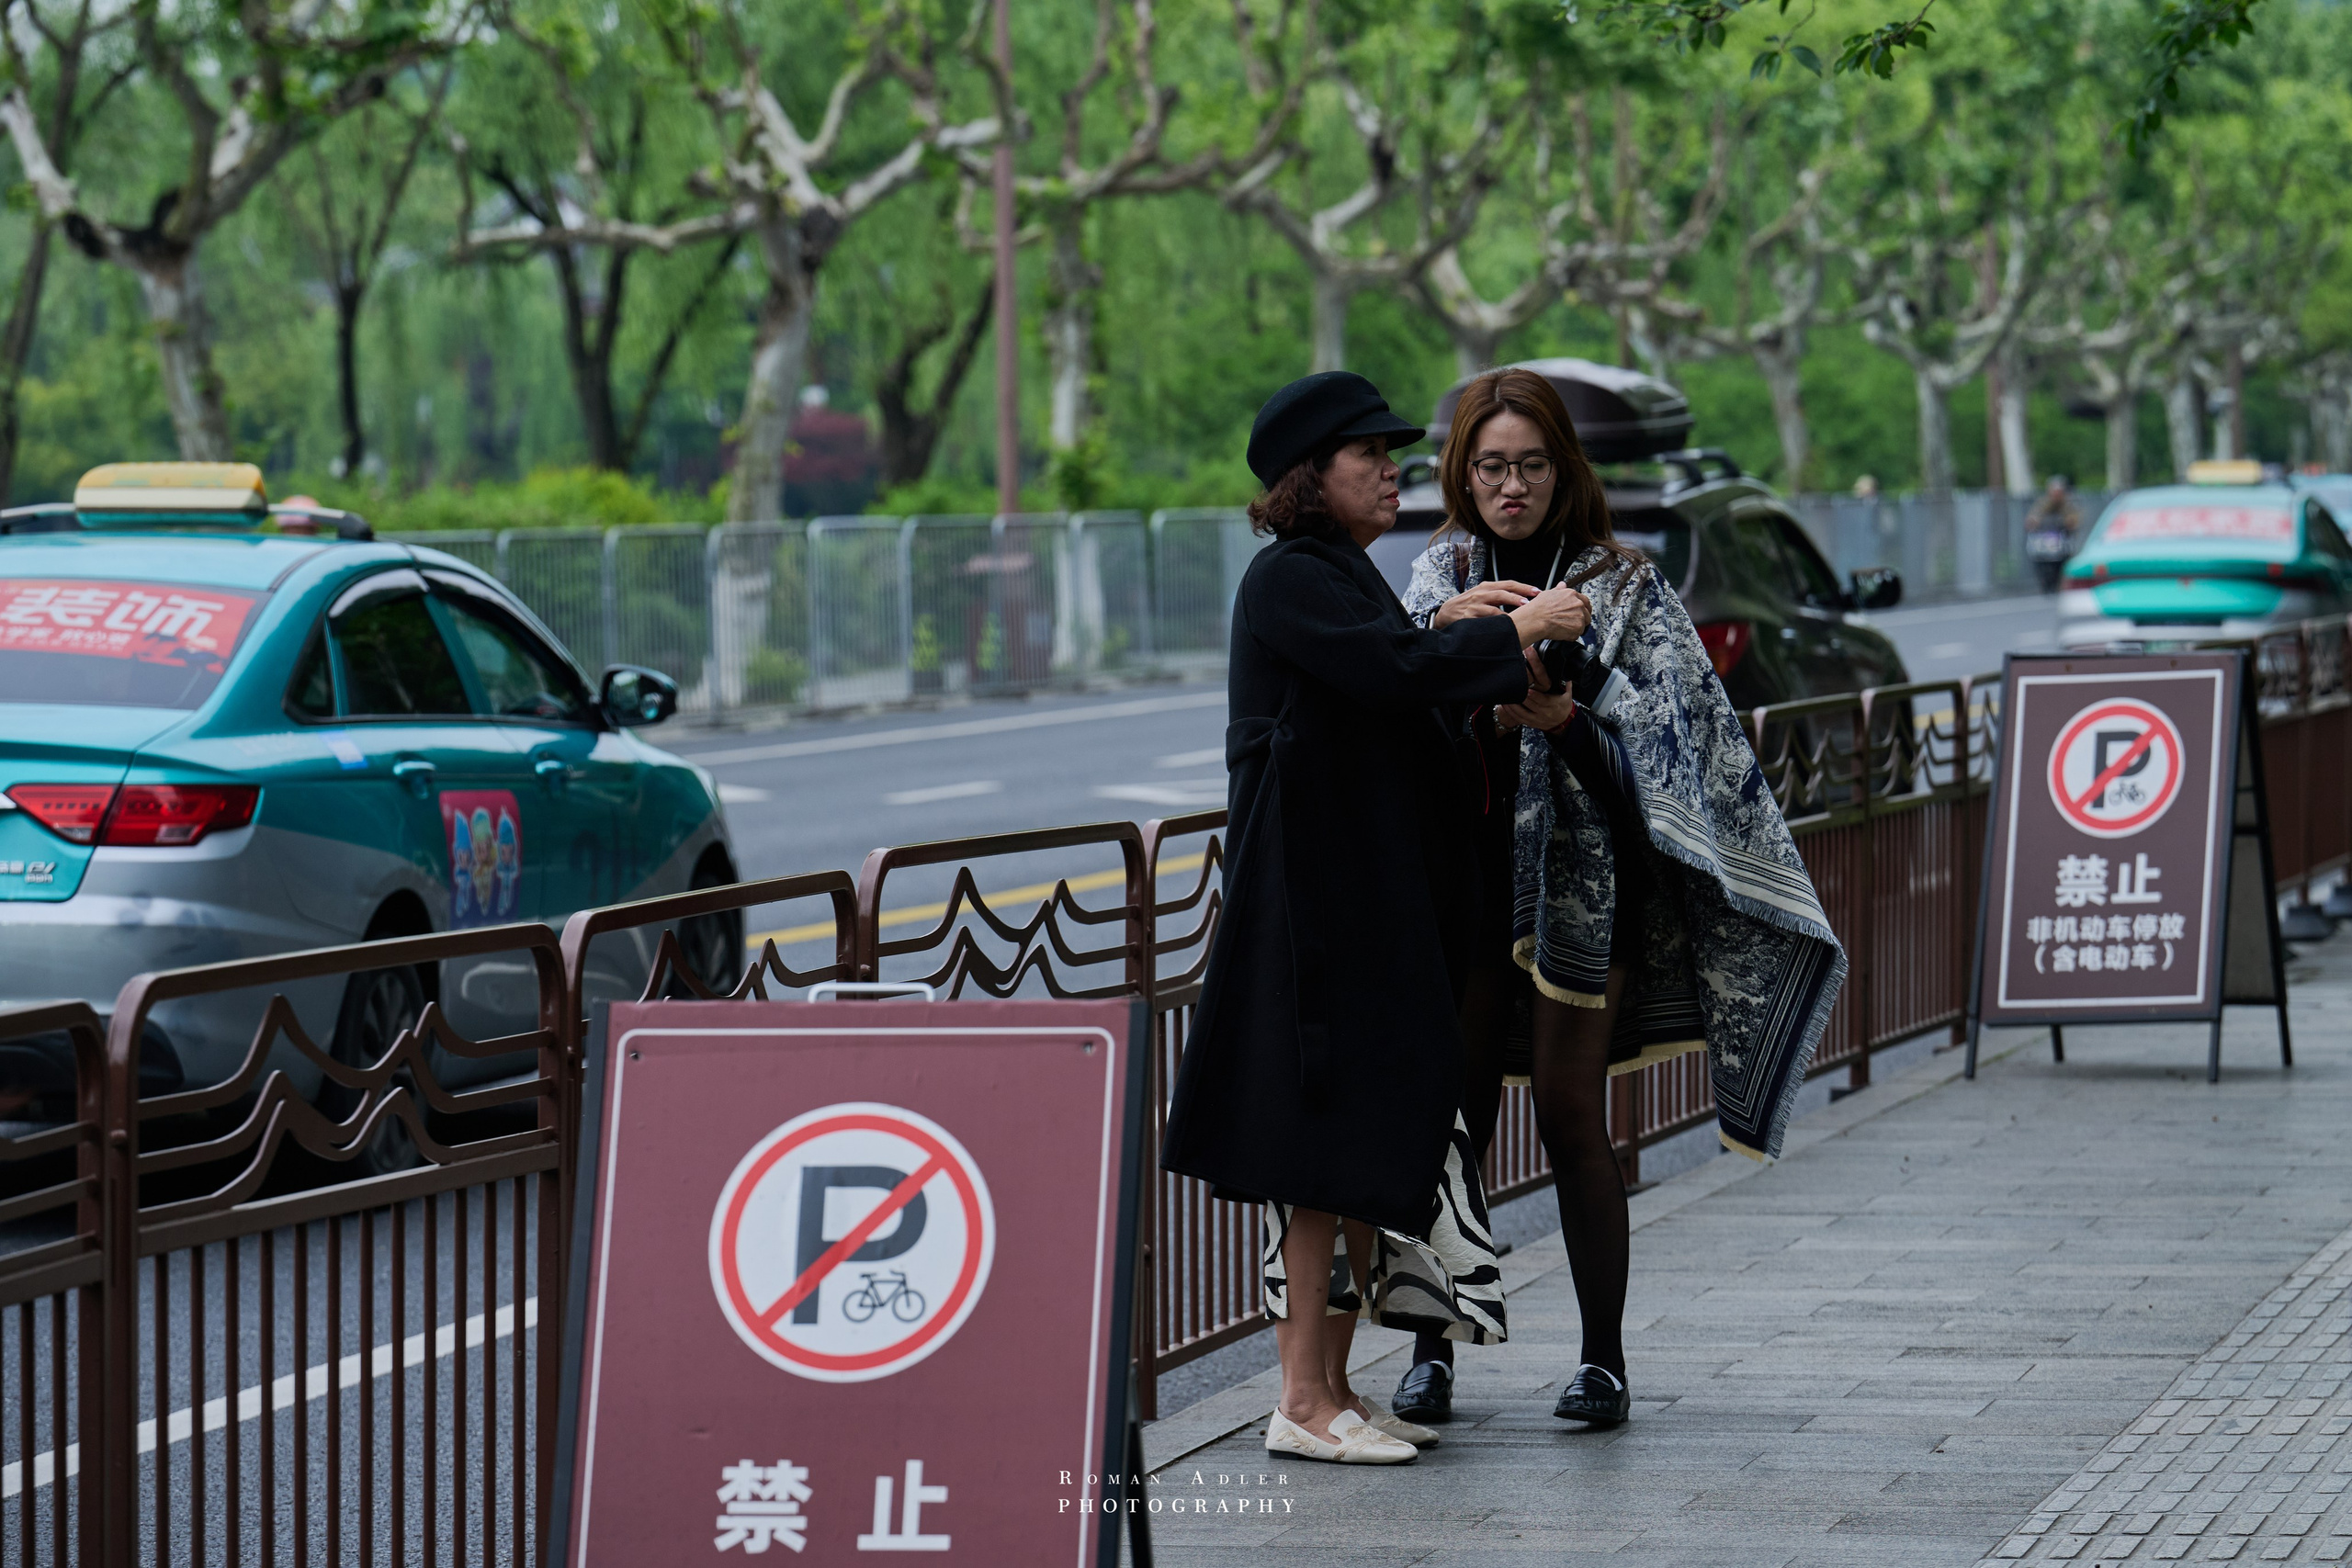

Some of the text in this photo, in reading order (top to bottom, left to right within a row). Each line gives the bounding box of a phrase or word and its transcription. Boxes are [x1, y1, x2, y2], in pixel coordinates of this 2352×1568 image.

[0, 586, 225, 639] 装饰
[2093, 731, 2151, 808] P
[2055, 852, 2162, 908] 禁止
[2026, 912, 2186, 944] 非机动车停放
[792, 1166, 927, 1325] P
[713, 1459, 951, 1554] 禁止
